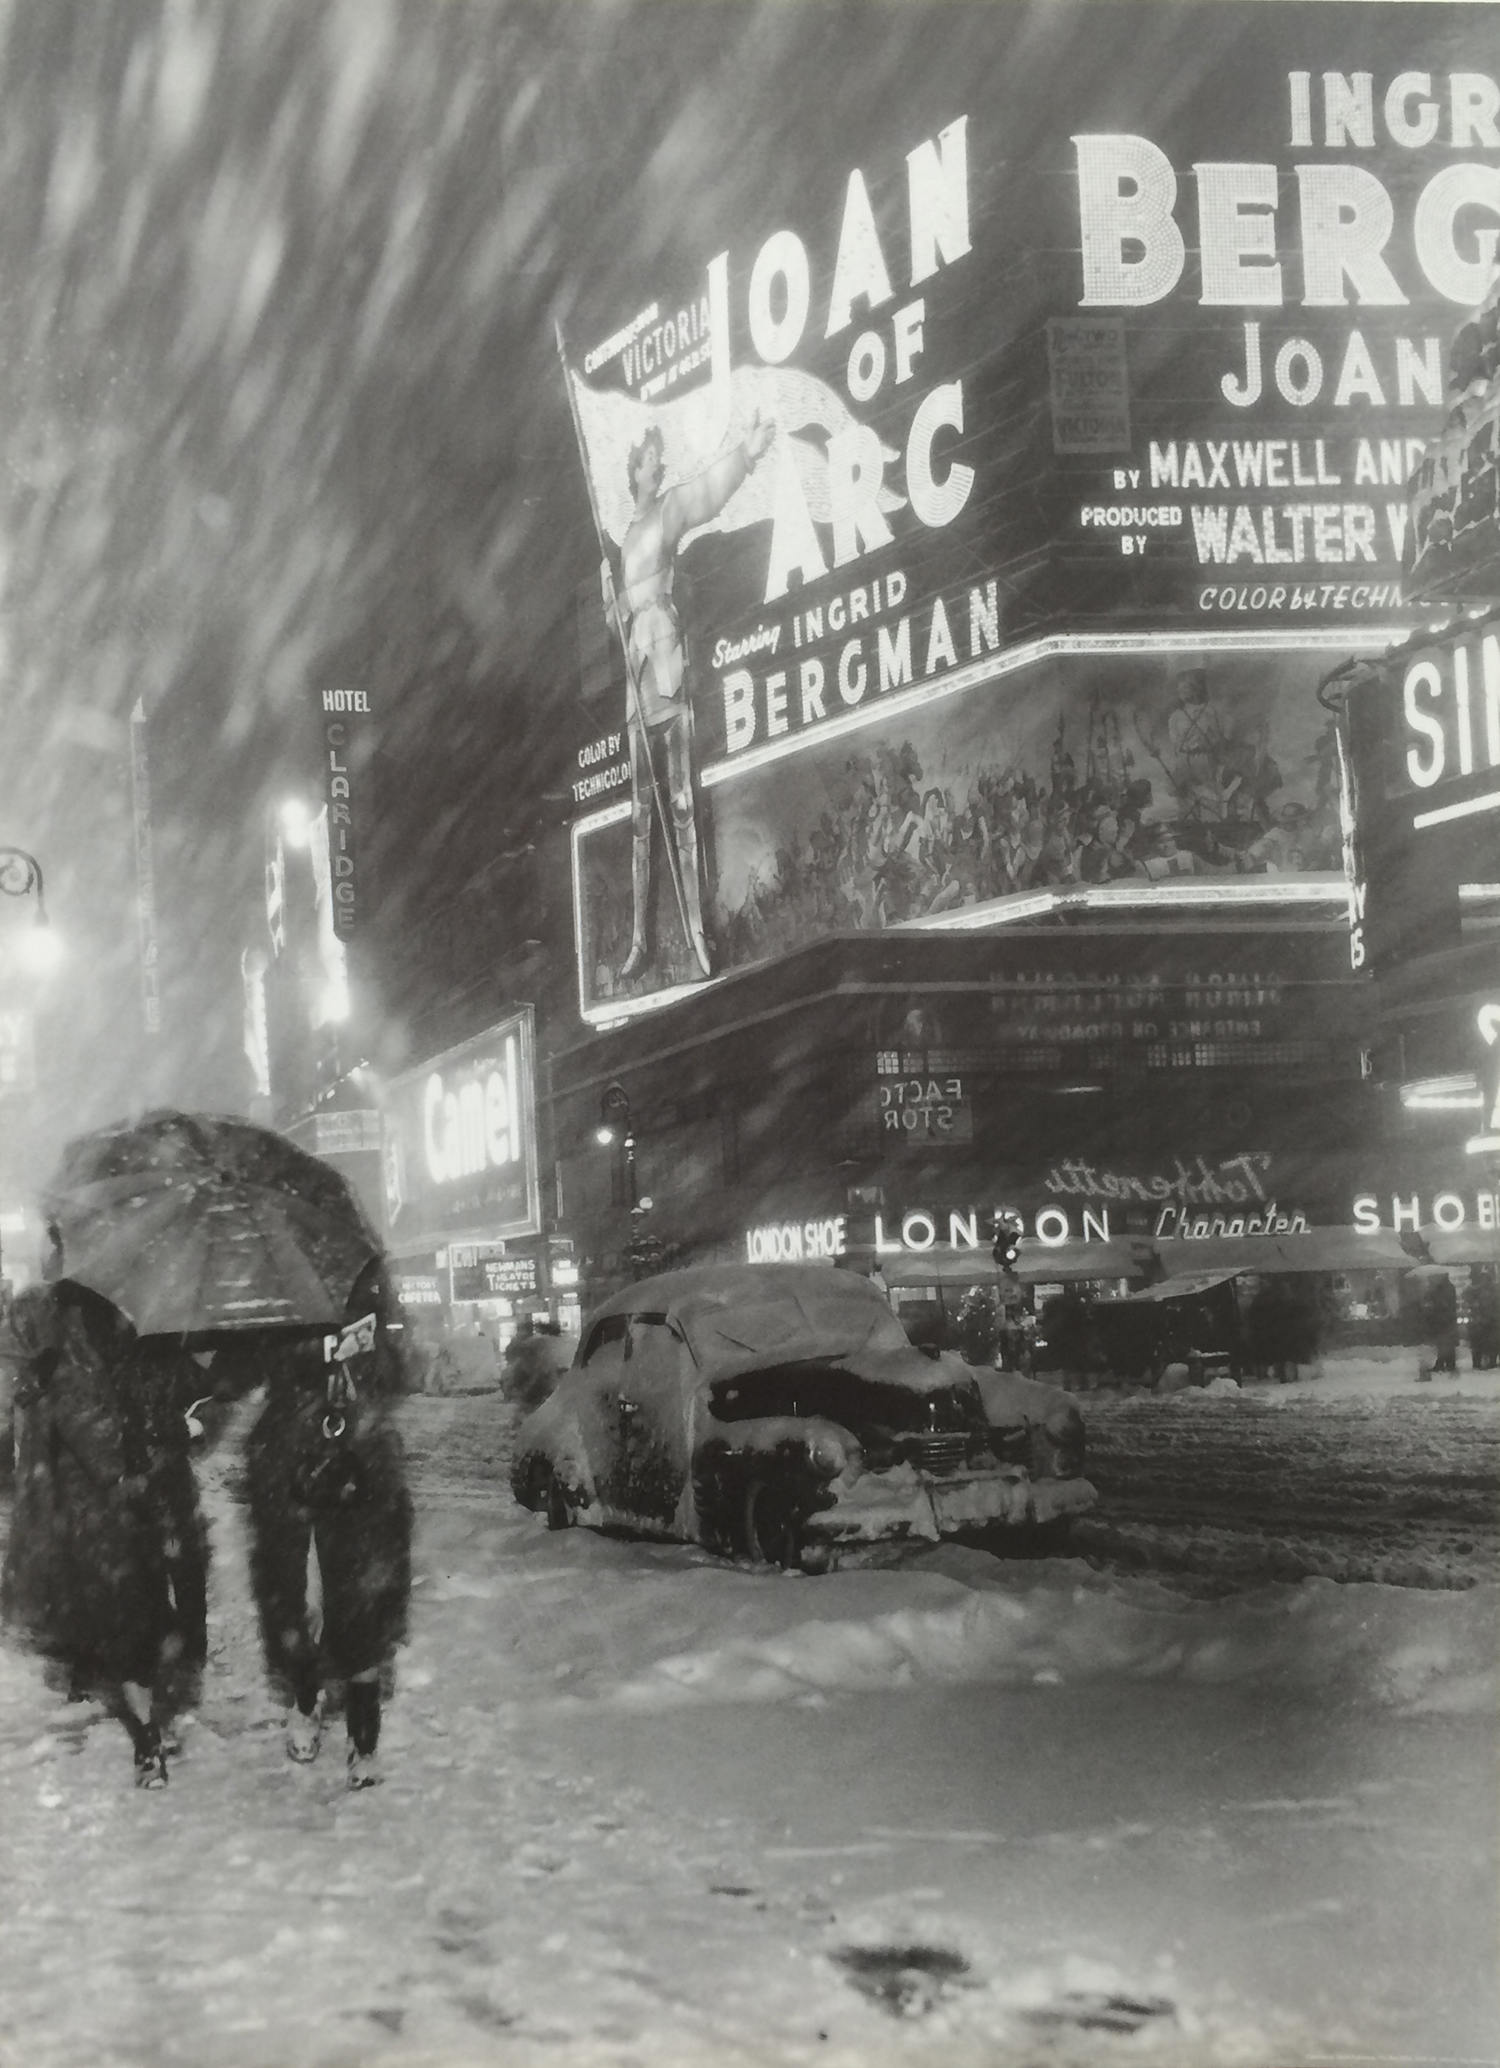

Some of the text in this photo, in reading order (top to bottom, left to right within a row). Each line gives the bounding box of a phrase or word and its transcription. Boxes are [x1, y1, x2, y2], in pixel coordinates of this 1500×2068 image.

[1288, 71, 1500, 148] INGR
[1070, 134, 1500, 306] BERG
[700, 114, 973, 455] JOAN
[621, 296, 712, 387] VICTORIA
[847, 298, 926, 402] OF
[1221, 321, 1443, 406] JOAN
[763, 379, 975, 605] ARC
[1113, 437, 1441, 490] BY MAXWELL AND
[1080, 505, 1183, 527] PRODUCED
[1121, 534, 1147, 555] BY
[1190, 502, 1377, 564] WALTER
[712, 571, 908, 669] Starring INGRID
[1198, 584, 1448, 611] COLOR by TECHN
[322, 689, 372, 713] HOTEL
[723, 580, 1001, 754] BERGMAN
[578, 732, 621, 768] COLOR BY
[326, 723, 355, 930] CLARIDGE
[424, 1035, 520, 1184] Camel
[746, 1215, 847, 1263] LONDON SHOE
[1156, 1202, 1312, 1240] Character
